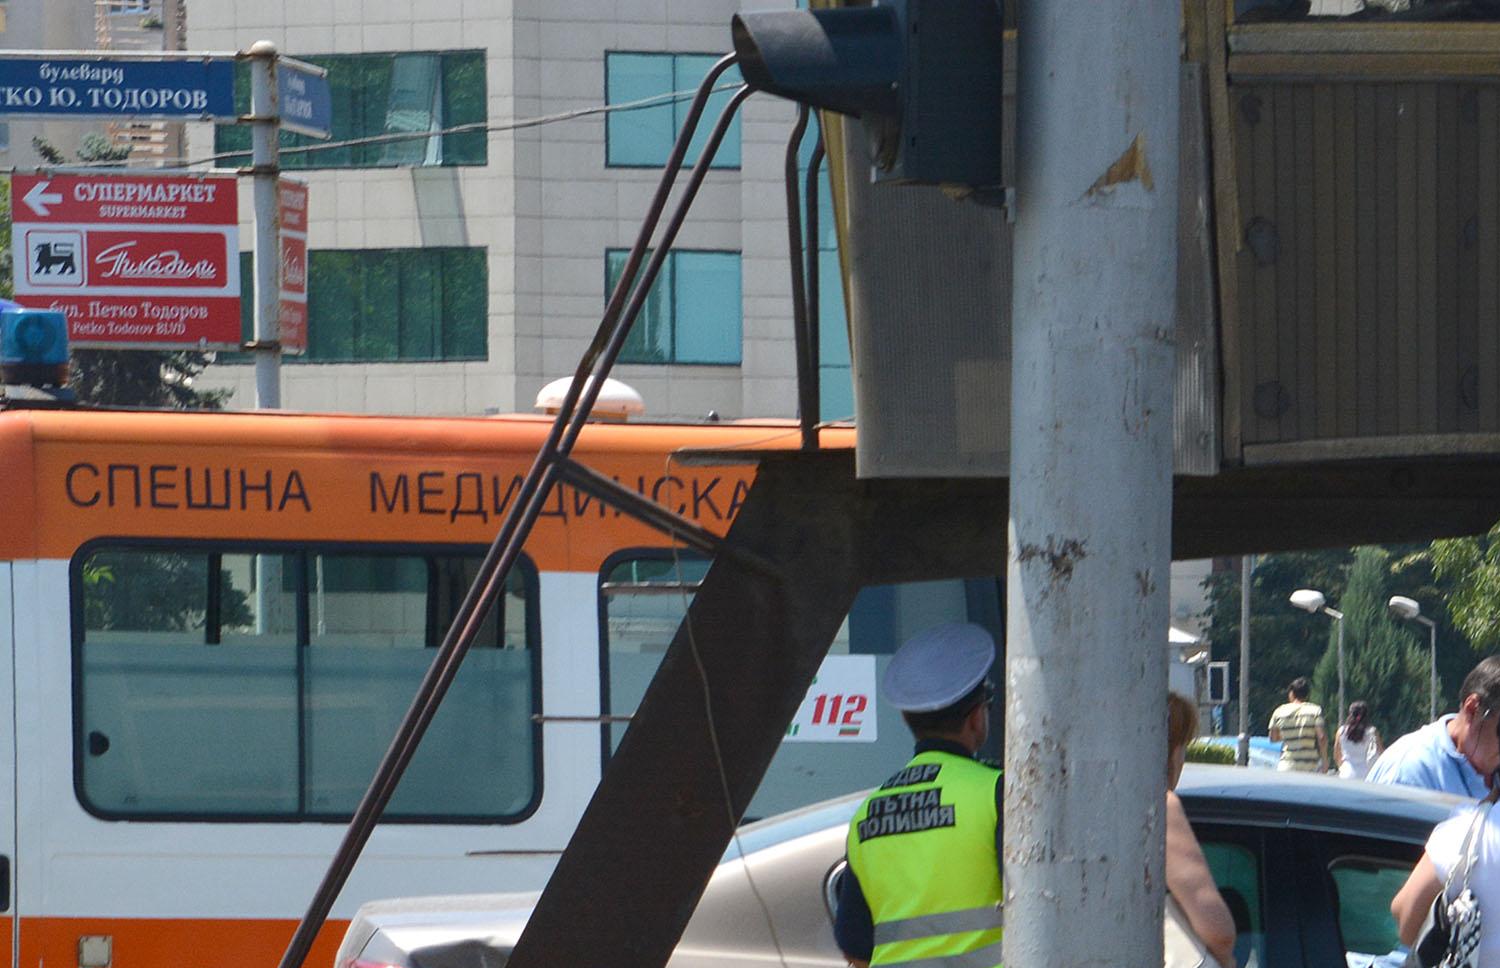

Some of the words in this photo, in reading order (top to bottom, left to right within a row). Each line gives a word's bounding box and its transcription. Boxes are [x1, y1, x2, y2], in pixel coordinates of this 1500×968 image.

[39, 63, 125, 85] булевард
[49, 87, 82, 107] Ю.
[87, 88, 208, 111] ТОДОРОВ
[74, 182, 217, 203] СУПЕРМАРКЕТ
[99, 204, 188, 219] SUPERMARKET
[88, 302, 138, 318] Петко
[141, 302, 209, 321] Тодоров
[72, 321, 106, 335] Petko
[107, 322, 154, 336] Todorov
[156, 322, 186, 335] BLVD
[65, 463, 312, 513] СПЕШНА
[811, 693, 868, 725] 112
[869, 789, 940, 817] ПЪТНА
[859, 806, 956, 840] ПОЛИЦИЯ
